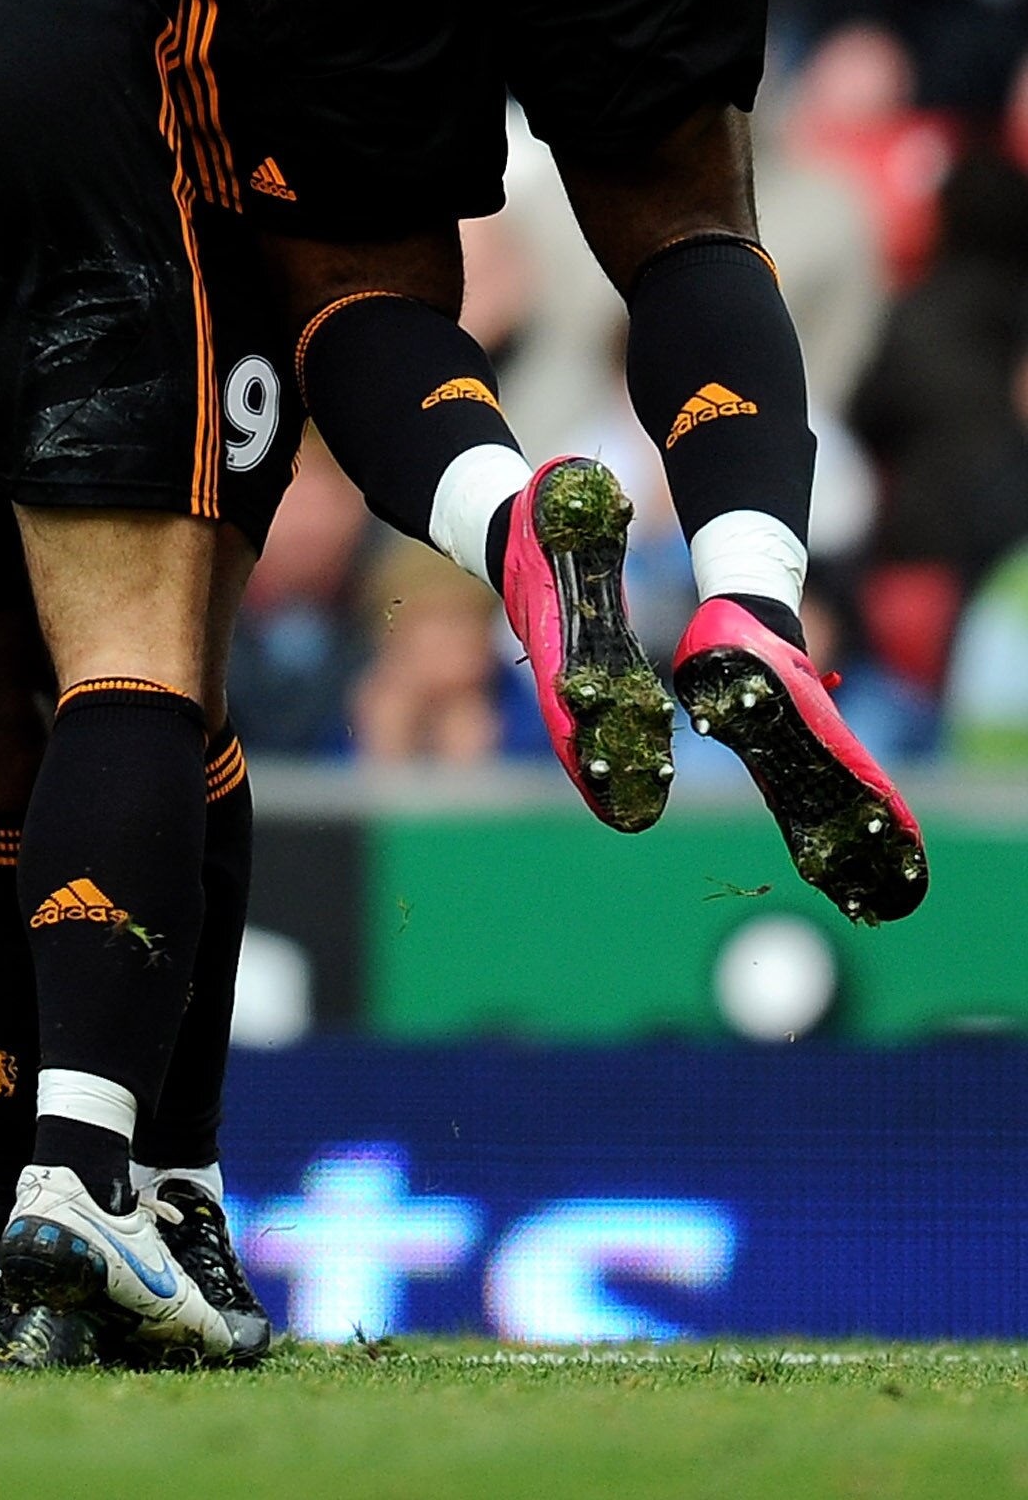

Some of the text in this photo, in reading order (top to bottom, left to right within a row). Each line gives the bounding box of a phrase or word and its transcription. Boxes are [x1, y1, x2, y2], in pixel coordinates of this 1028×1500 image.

[223, 354, 281, 472] 9
[421, 385, 501, 411] adida
[666, 400, 758, 450] adidas
[29, 904, 128, 929] adidas
